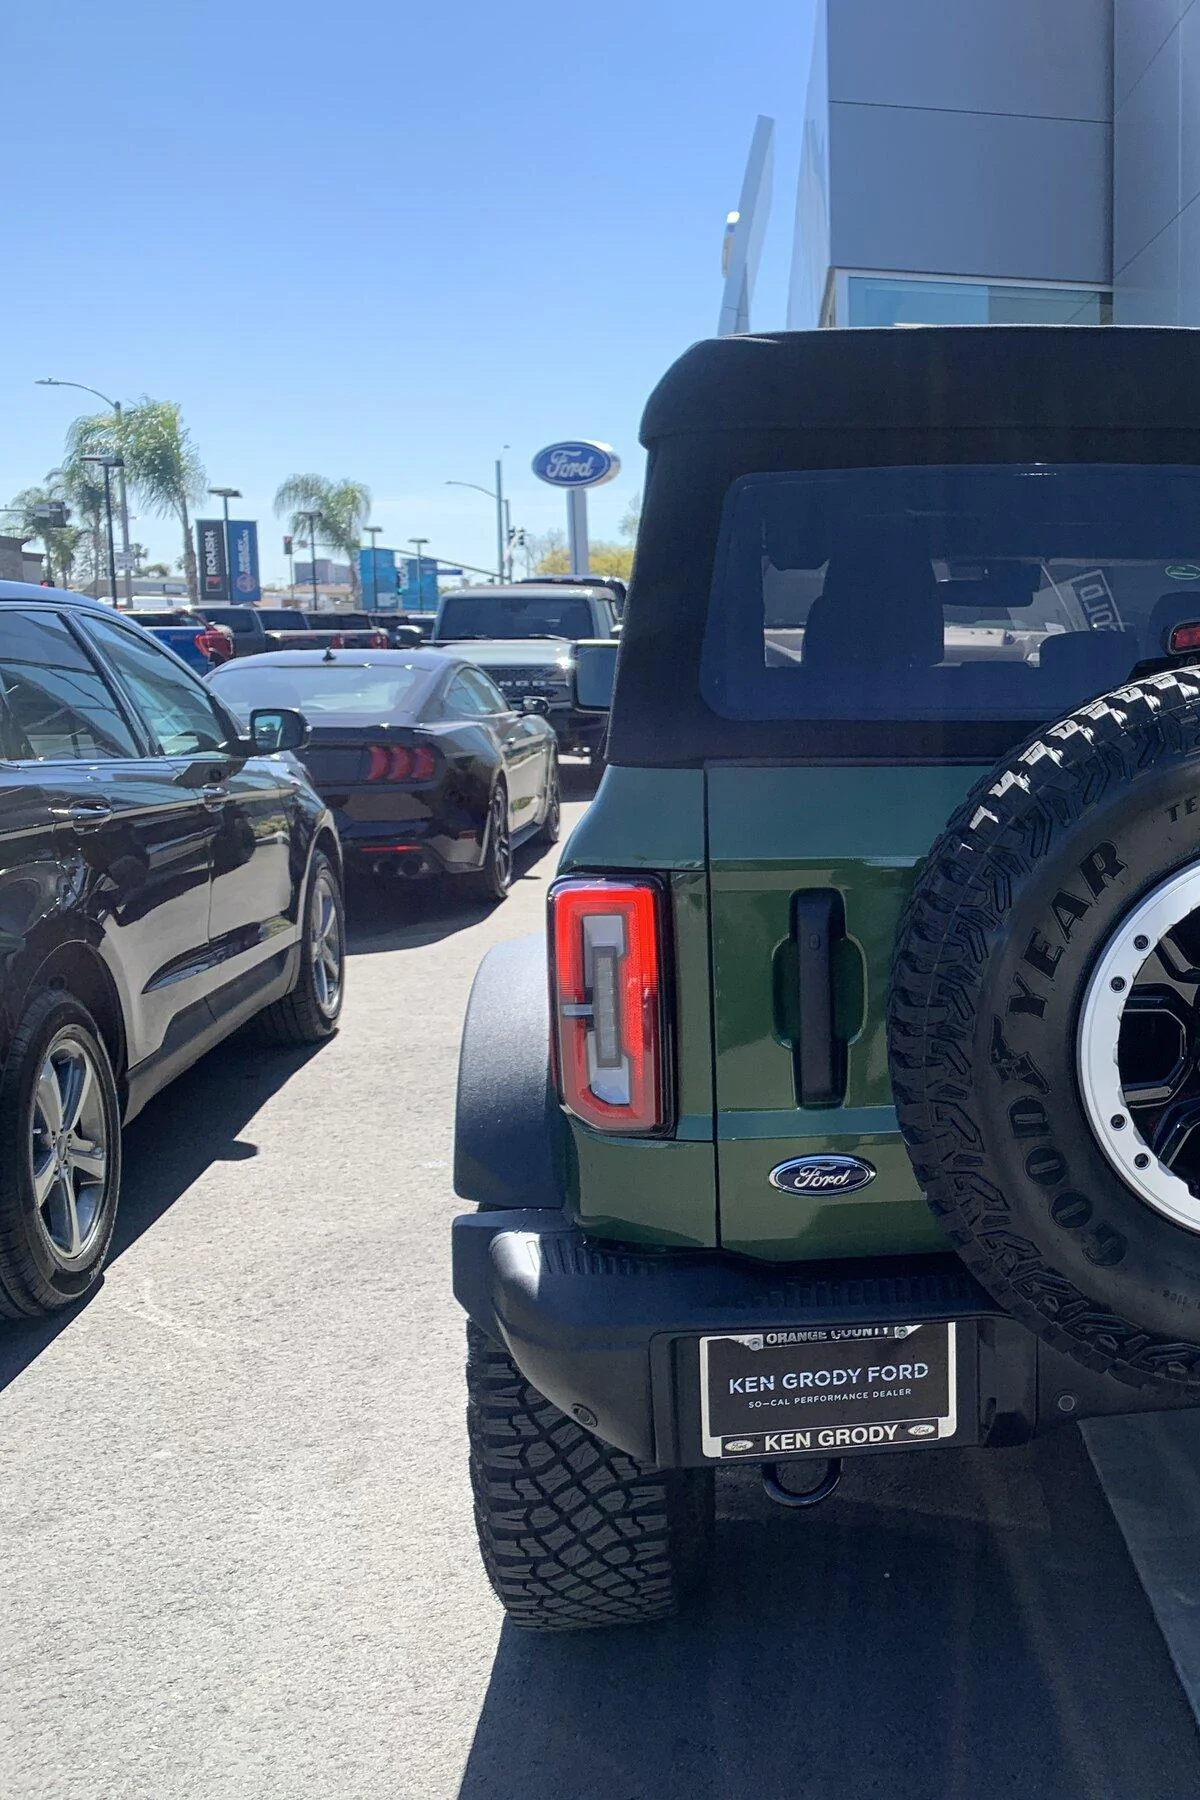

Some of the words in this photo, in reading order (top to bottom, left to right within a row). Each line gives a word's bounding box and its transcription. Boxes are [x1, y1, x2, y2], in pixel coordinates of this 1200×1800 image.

[546, 450, 595, 478] Ford
[205, 529, 216, 575] ROUSH
[794, 1165, 851, 1188] Ford
[766, 1331, 827, 1345] ORANGE
[729, 1375, 775, 1394] KEN
[782, 1367, 862, 1390] GRODY
[868, 1363, 930, 1382] FORD
[748, 1398, 790, 1409] SO-CAL
[794, 1391, 869, 1405] PERFORMANCE
[872, 1388, 912, 1399] DEALER
[764, 1432, 812, 1451] KEN
[818, 1424, 899, 1447] GRODY
